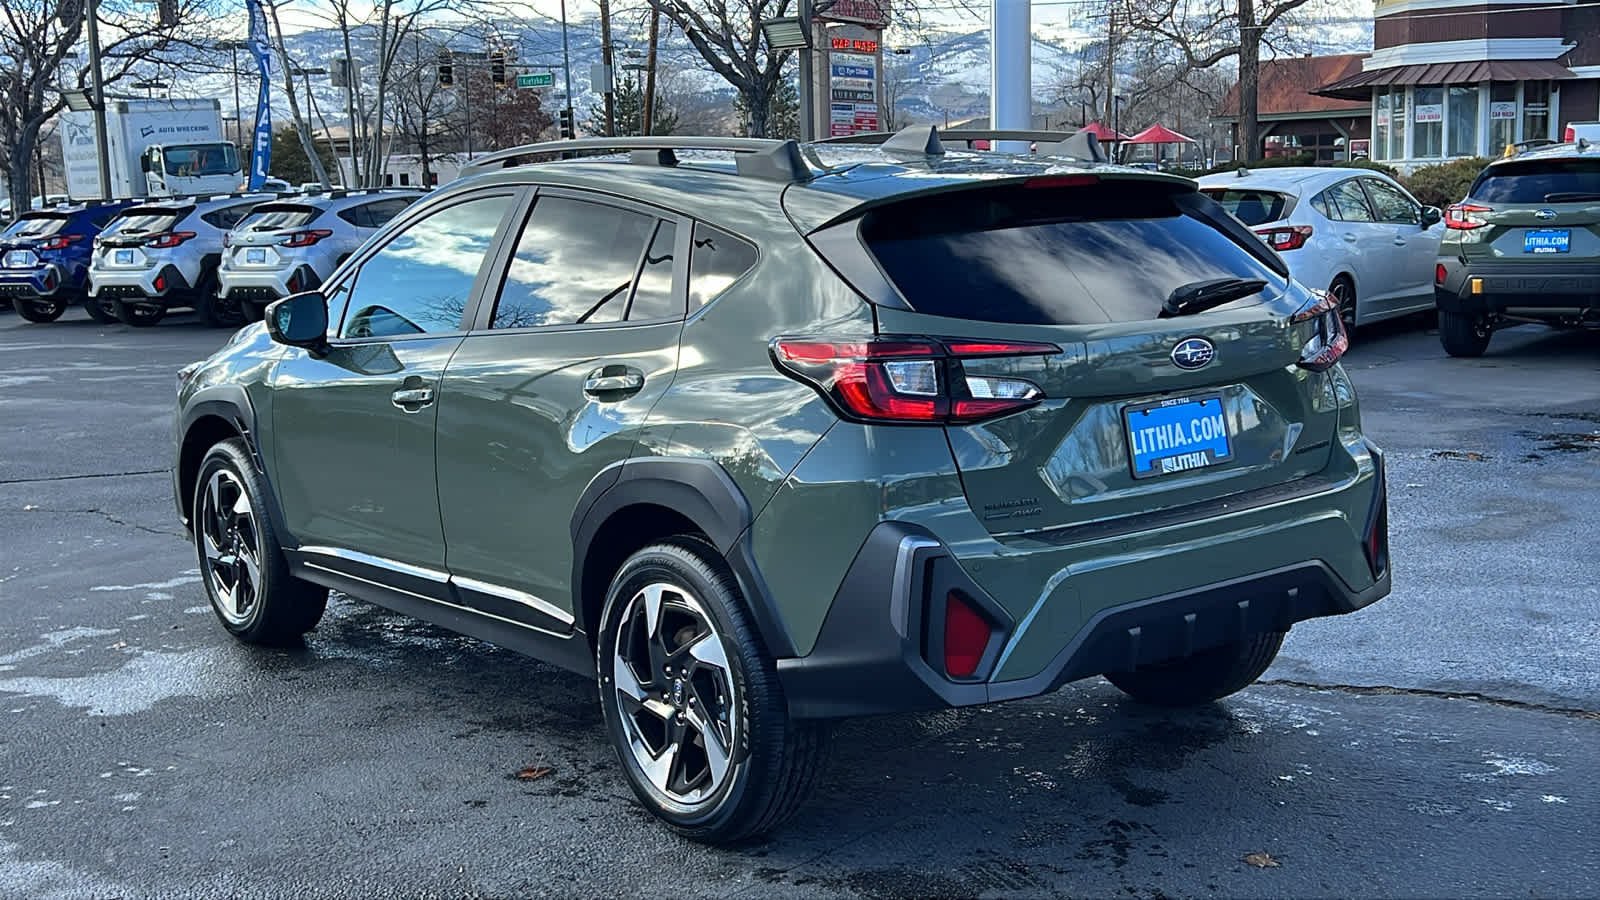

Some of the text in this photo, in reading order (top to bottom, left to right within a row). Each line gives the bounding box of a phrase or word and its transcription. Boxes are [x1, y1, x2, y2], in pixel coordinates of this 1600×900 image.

[853, 40, 877, 51] WASH
[1525, 236, 1569, 246] LITHIA.COM
[1131, 413, 1227, 456] LITHIA.COM
[1172, 451, 1210, 472] LITHIA
